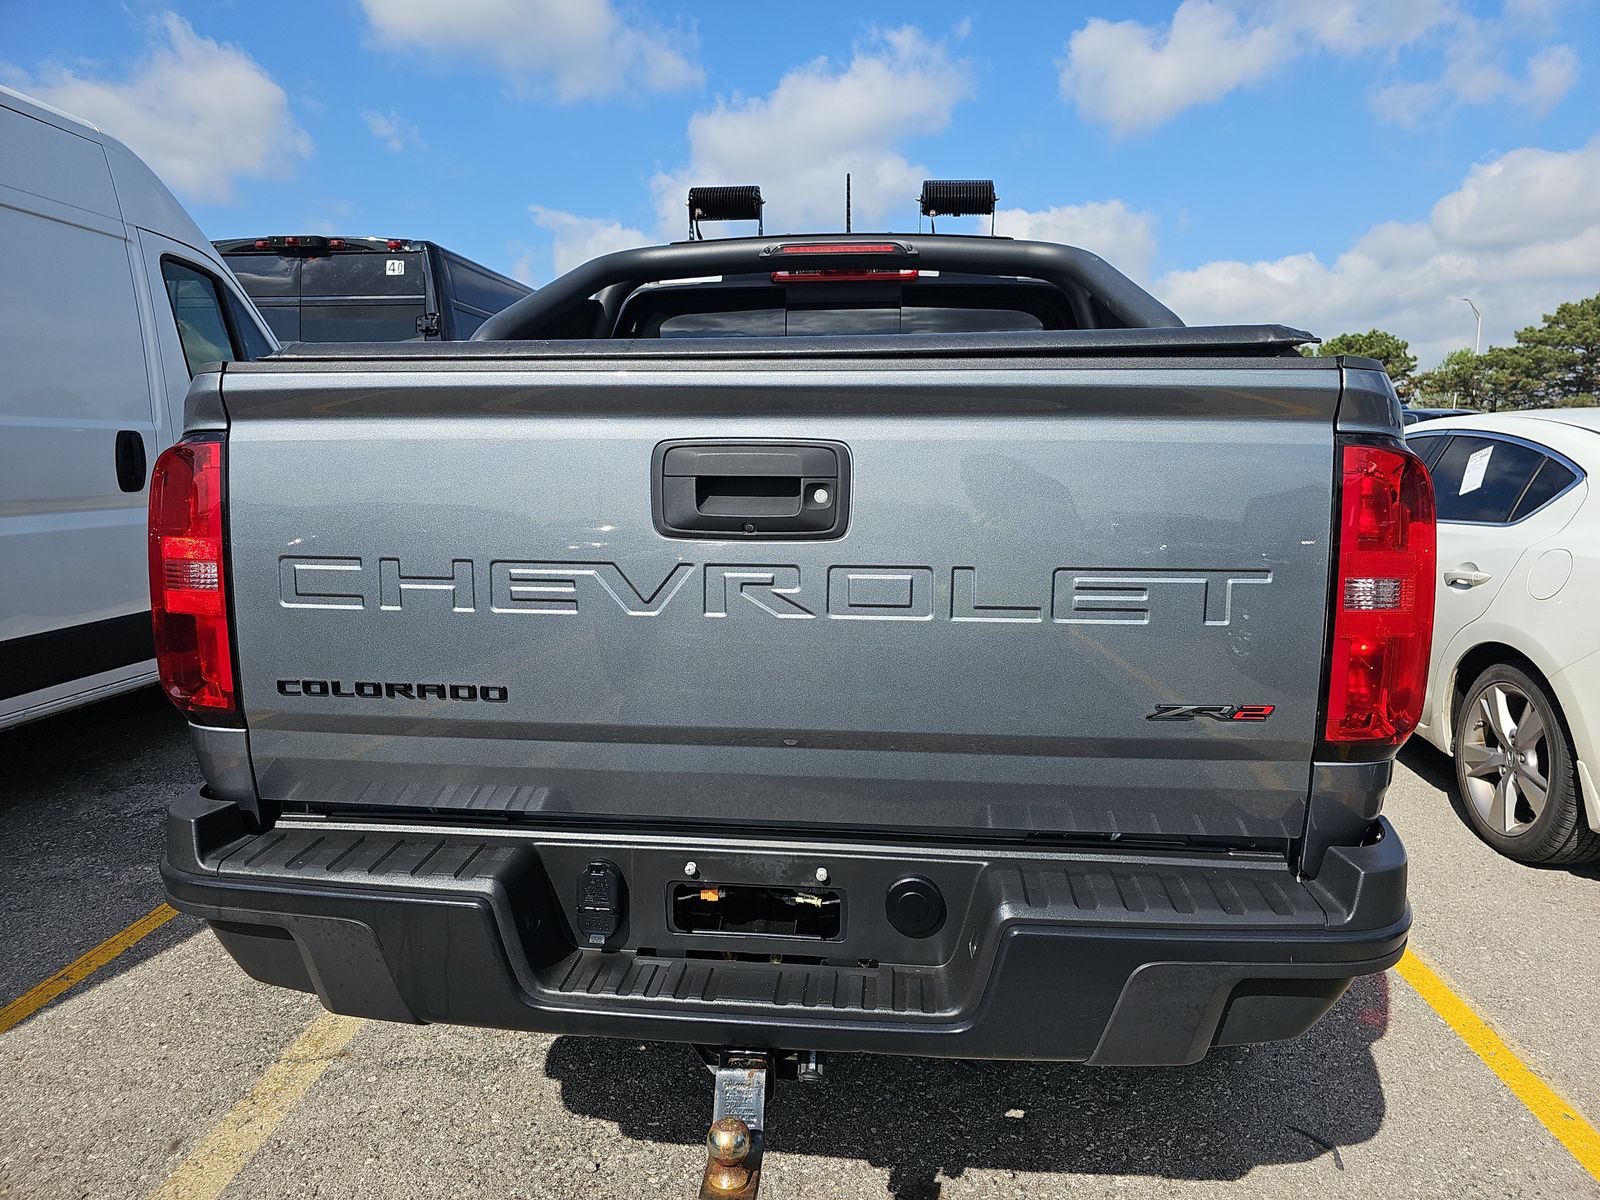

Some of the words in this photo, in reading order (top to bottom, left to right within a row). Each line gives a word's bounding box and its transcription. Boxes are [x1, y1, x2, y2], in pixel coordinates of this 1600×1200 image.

[388, 261, 403, 274] 40
[279, 556, 1273, 626] CHEVROLET
[277, 679, 508, 703] COLORADO
[1146, 704, 1276, 722] ZR2
